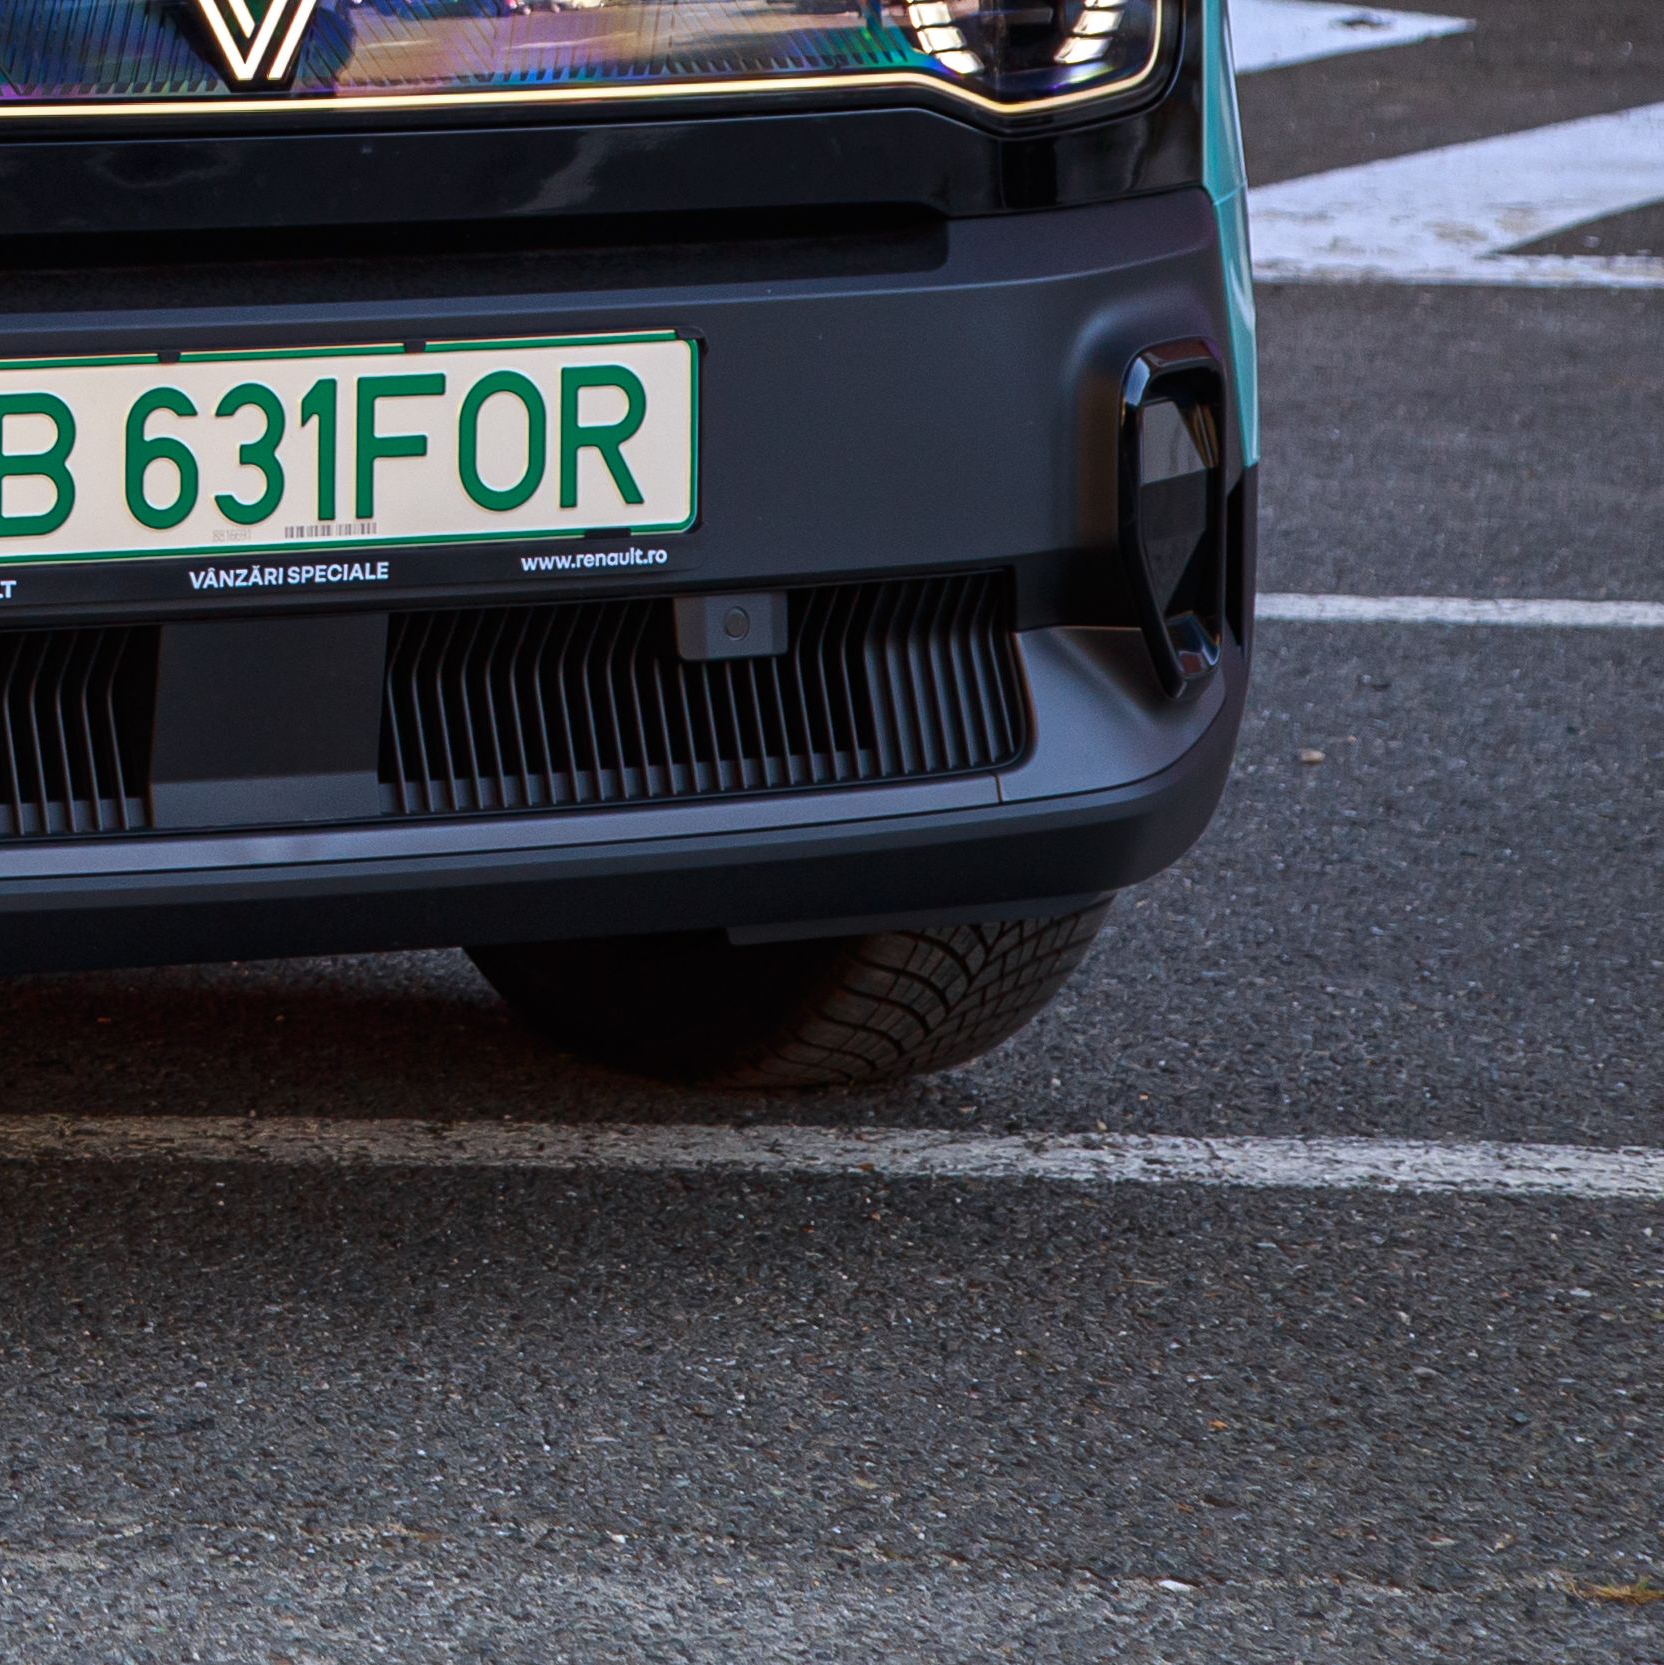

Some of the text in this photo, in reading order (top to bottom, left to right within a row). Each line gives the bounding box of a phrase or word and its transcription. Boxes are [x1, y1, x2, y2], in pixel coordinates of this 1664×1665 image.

[124, 363, 648, 531] 631FOR
[520, 546, 668, 572] www.renault.ro
[189, 561, 390, 590] VÂNZĂRI SPECIALE
